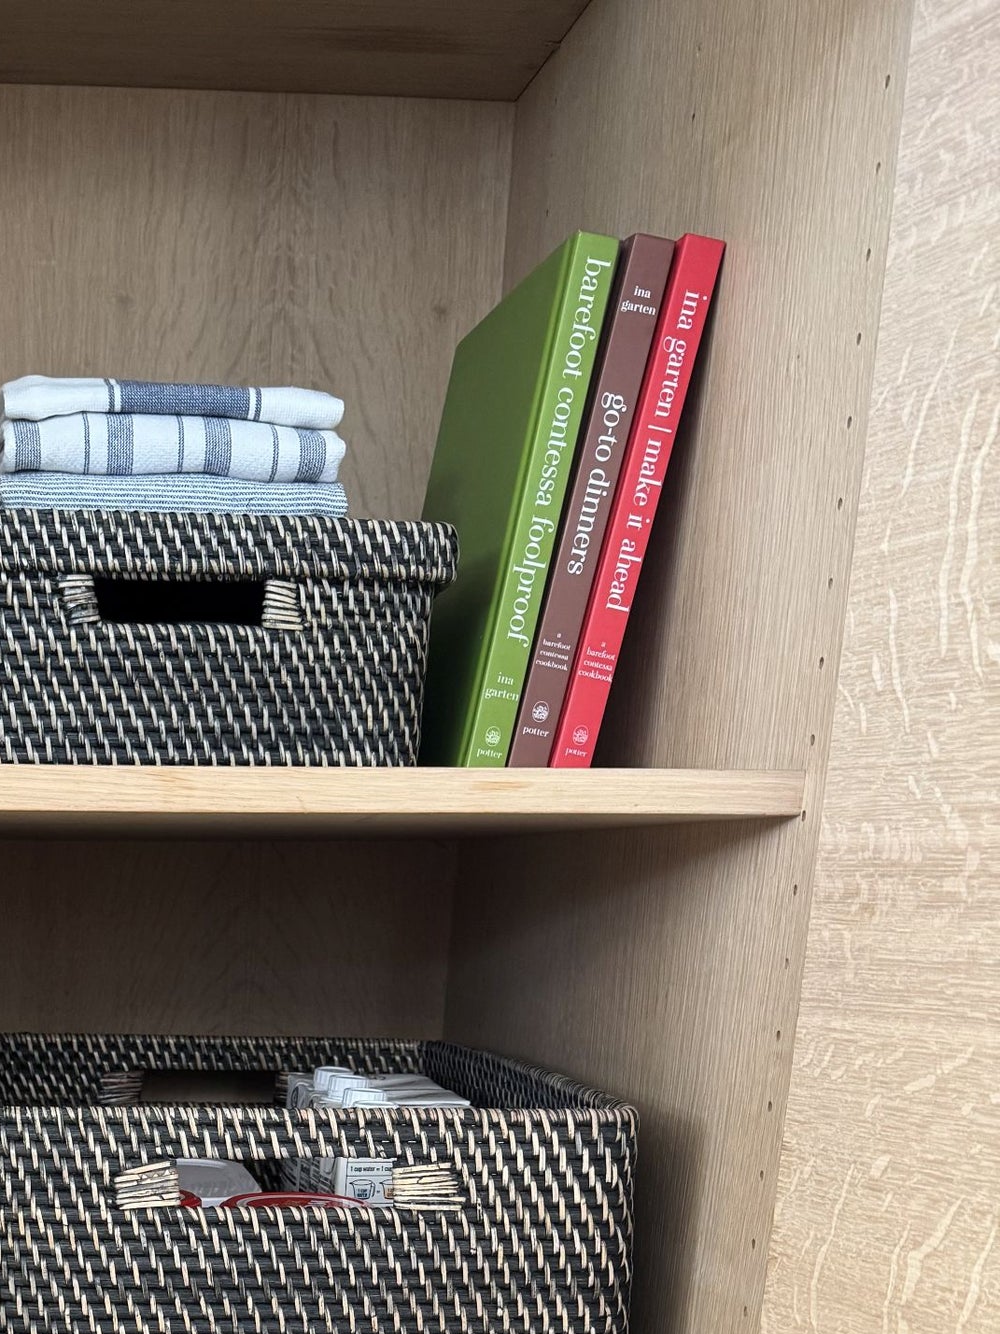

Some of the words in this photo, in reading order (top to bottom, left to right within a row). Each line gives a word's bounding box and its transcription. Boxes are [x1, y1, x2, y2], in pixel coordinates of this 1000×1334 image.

[633, 285, 651, 298] ina
[621, 300, 656, 316] garten
[676, 288, 707, 330] ina
[562, 256, 611, 380] barefoot
[654, 336, 687, 417] garten
[601, 391, 627, 462] go-to
[535, 387, 574, 507] contessa
[633, 438, 662, 507] make
[567, 468, 611, 575] dinners
[626, 513, 651, 530] it
[507, 516, 555, 648] foolproof
[606, 538, 642, 612] ahead
[542, 638, 571, 651] barefoot
[539, 649, 569, 661] contessa
[586, 646, 616, 661] barefoot
[535, 659, 568, 671] cookbook
[583, 659, 612, 671] contessa
[497, 671, 514, 685] ina
[578, 669, 613, 683] cookbook
[484, 686, 519, 702] garten
[523, 725, 550, 738] potter
[476, 747, 503, 759] potter
[564, 746, 588, 758] potter
